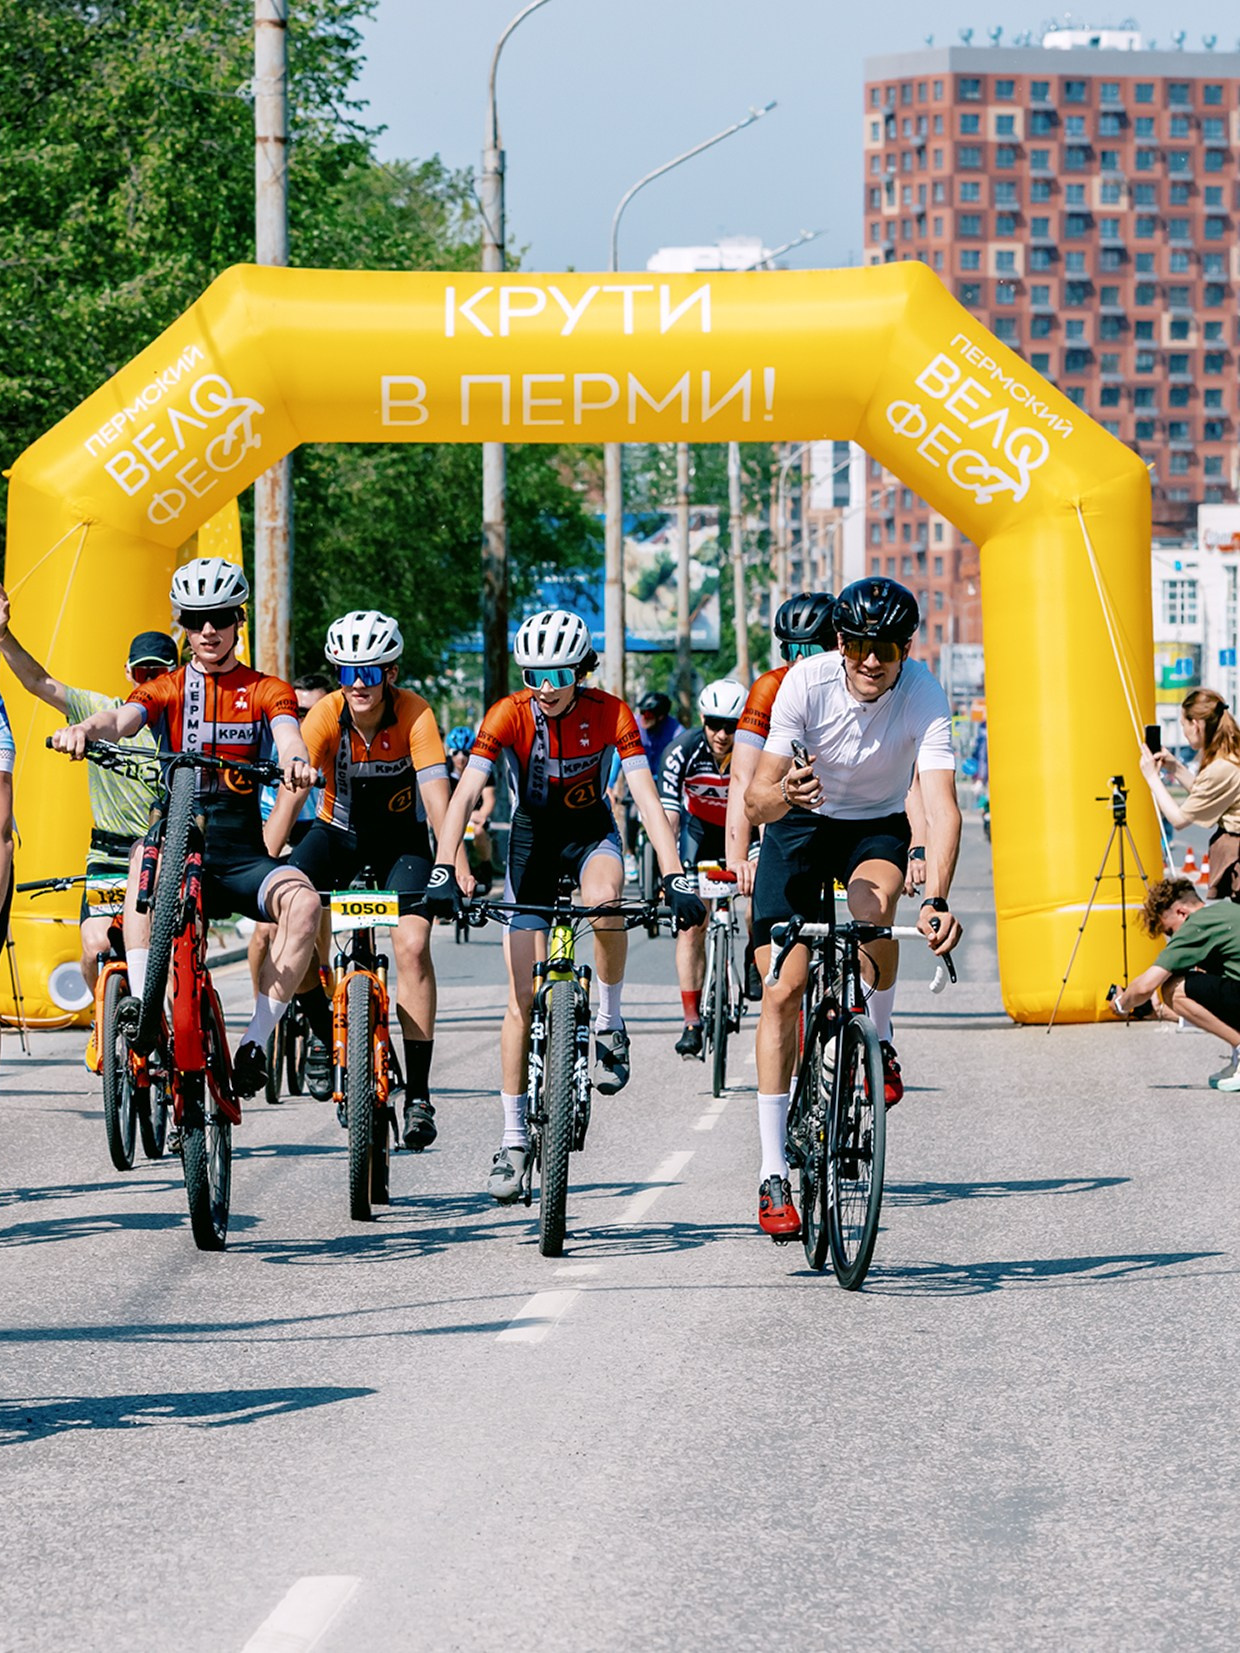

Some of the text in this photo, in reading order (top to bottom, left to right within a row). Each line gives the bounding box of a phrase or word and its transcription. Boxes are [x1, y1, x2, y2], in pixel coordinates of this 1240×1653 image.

[444, 283, 711, 338] КРУТИ
[83, 344, 205, 457] ПЕРМСКИЙ
[381, 366, 776, 427] В ПЕРМИ!
[949, 332, 1074, 439] ПЕРМСКИЙ
[575, 784, 595, 802] 21
[662, 745, 685, 798] FAST
[341, 902, 387, 915] 1050
